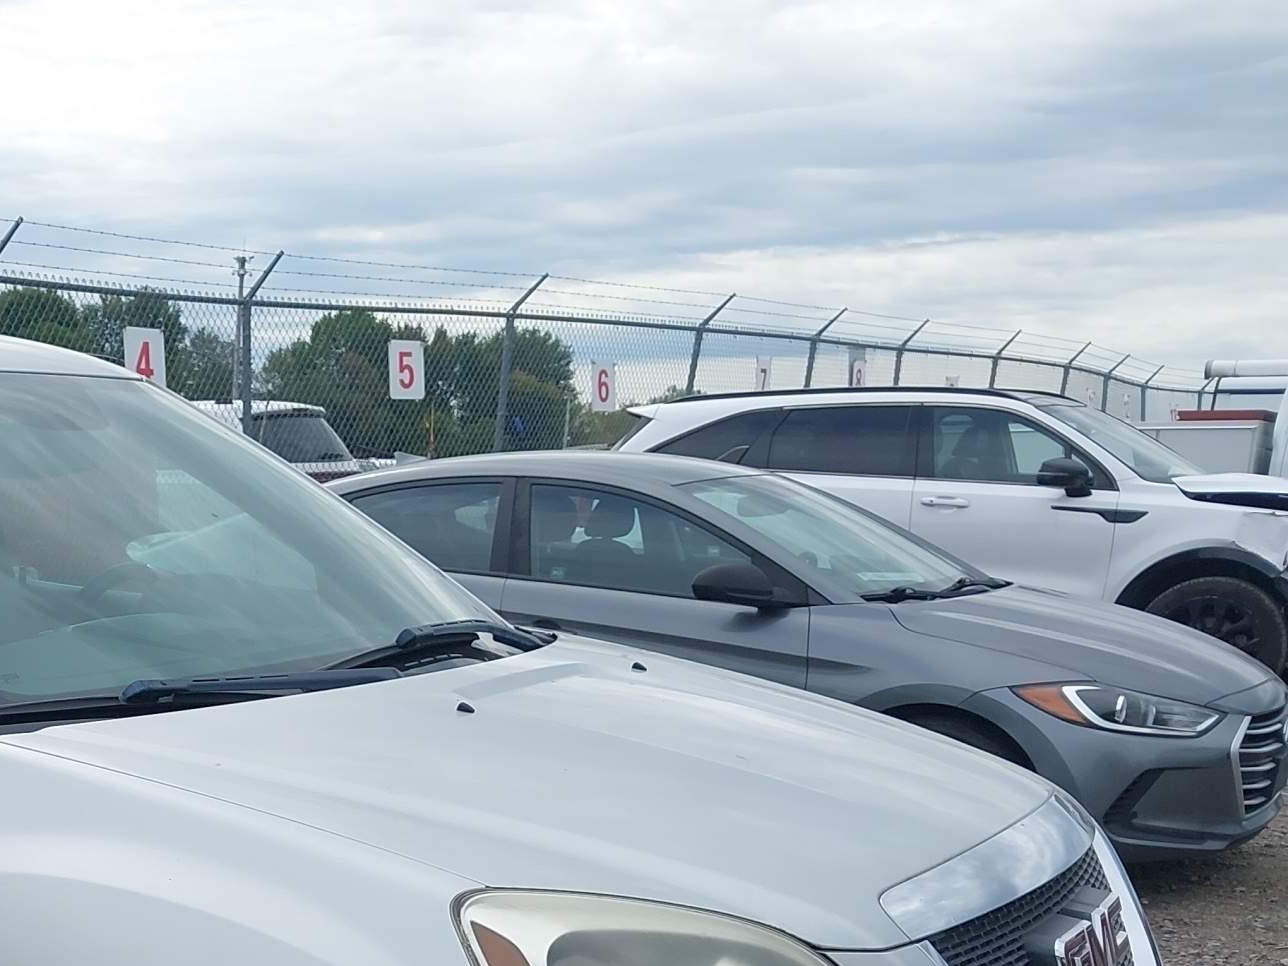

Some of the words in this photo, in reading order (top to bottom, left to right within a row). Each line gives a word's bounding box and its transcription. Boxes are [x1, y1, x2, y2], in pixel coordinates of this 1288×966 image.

[136, 341, 154, 378] 4
[398, 351, 414, 389] 5
[598, 369, 609, 402] 6
